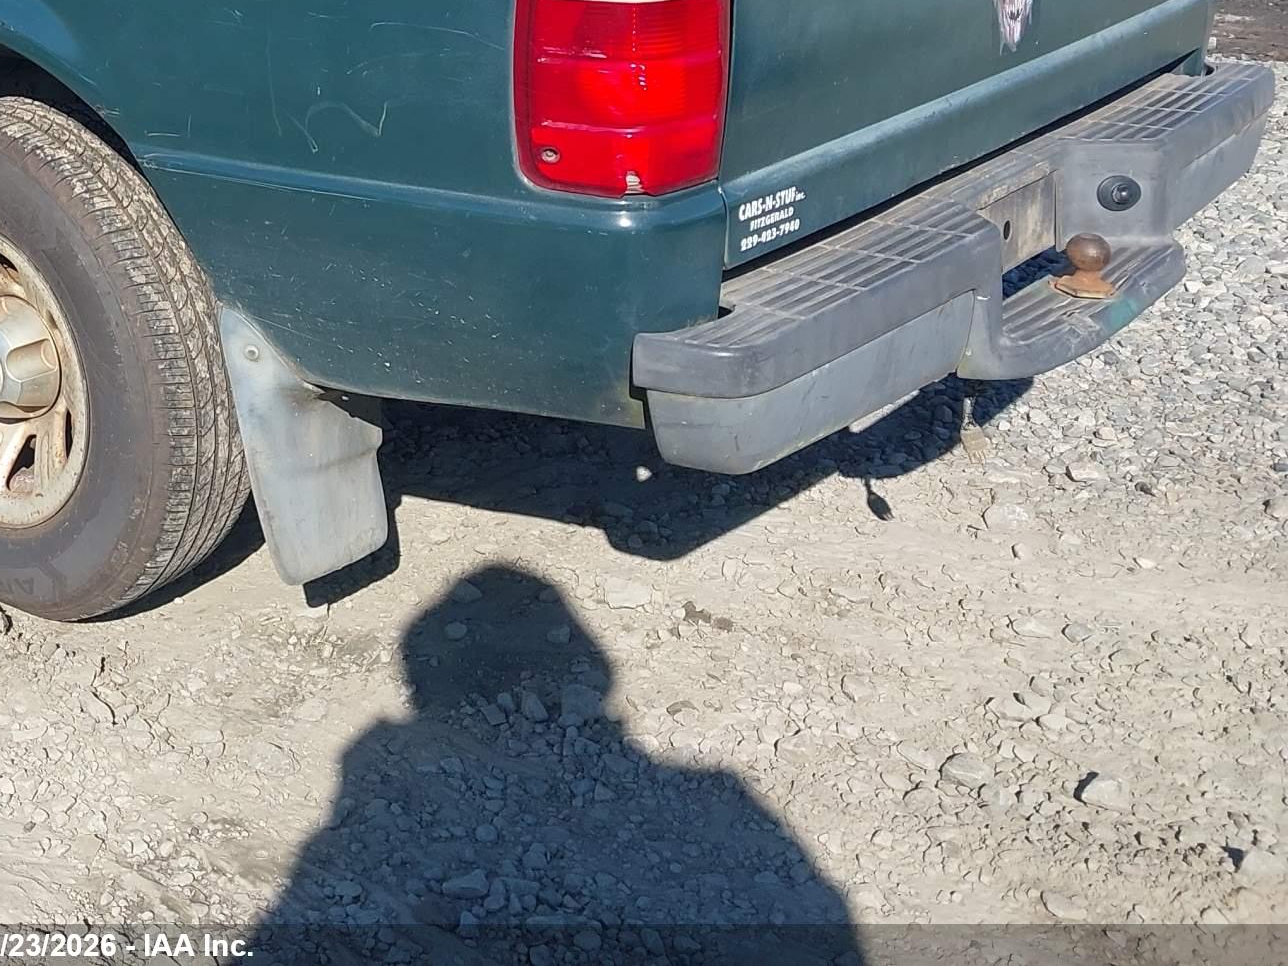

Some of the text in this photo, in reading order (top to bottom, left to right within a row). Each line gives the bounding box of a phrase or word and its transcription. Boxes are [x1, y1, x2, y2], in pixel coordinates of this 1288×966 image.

[739, 186, 796, 221] CARS-N-STUF
[750, 207, 794, 231] FITZGERALD
[740, 219, 800, 251] 229-423-7940
